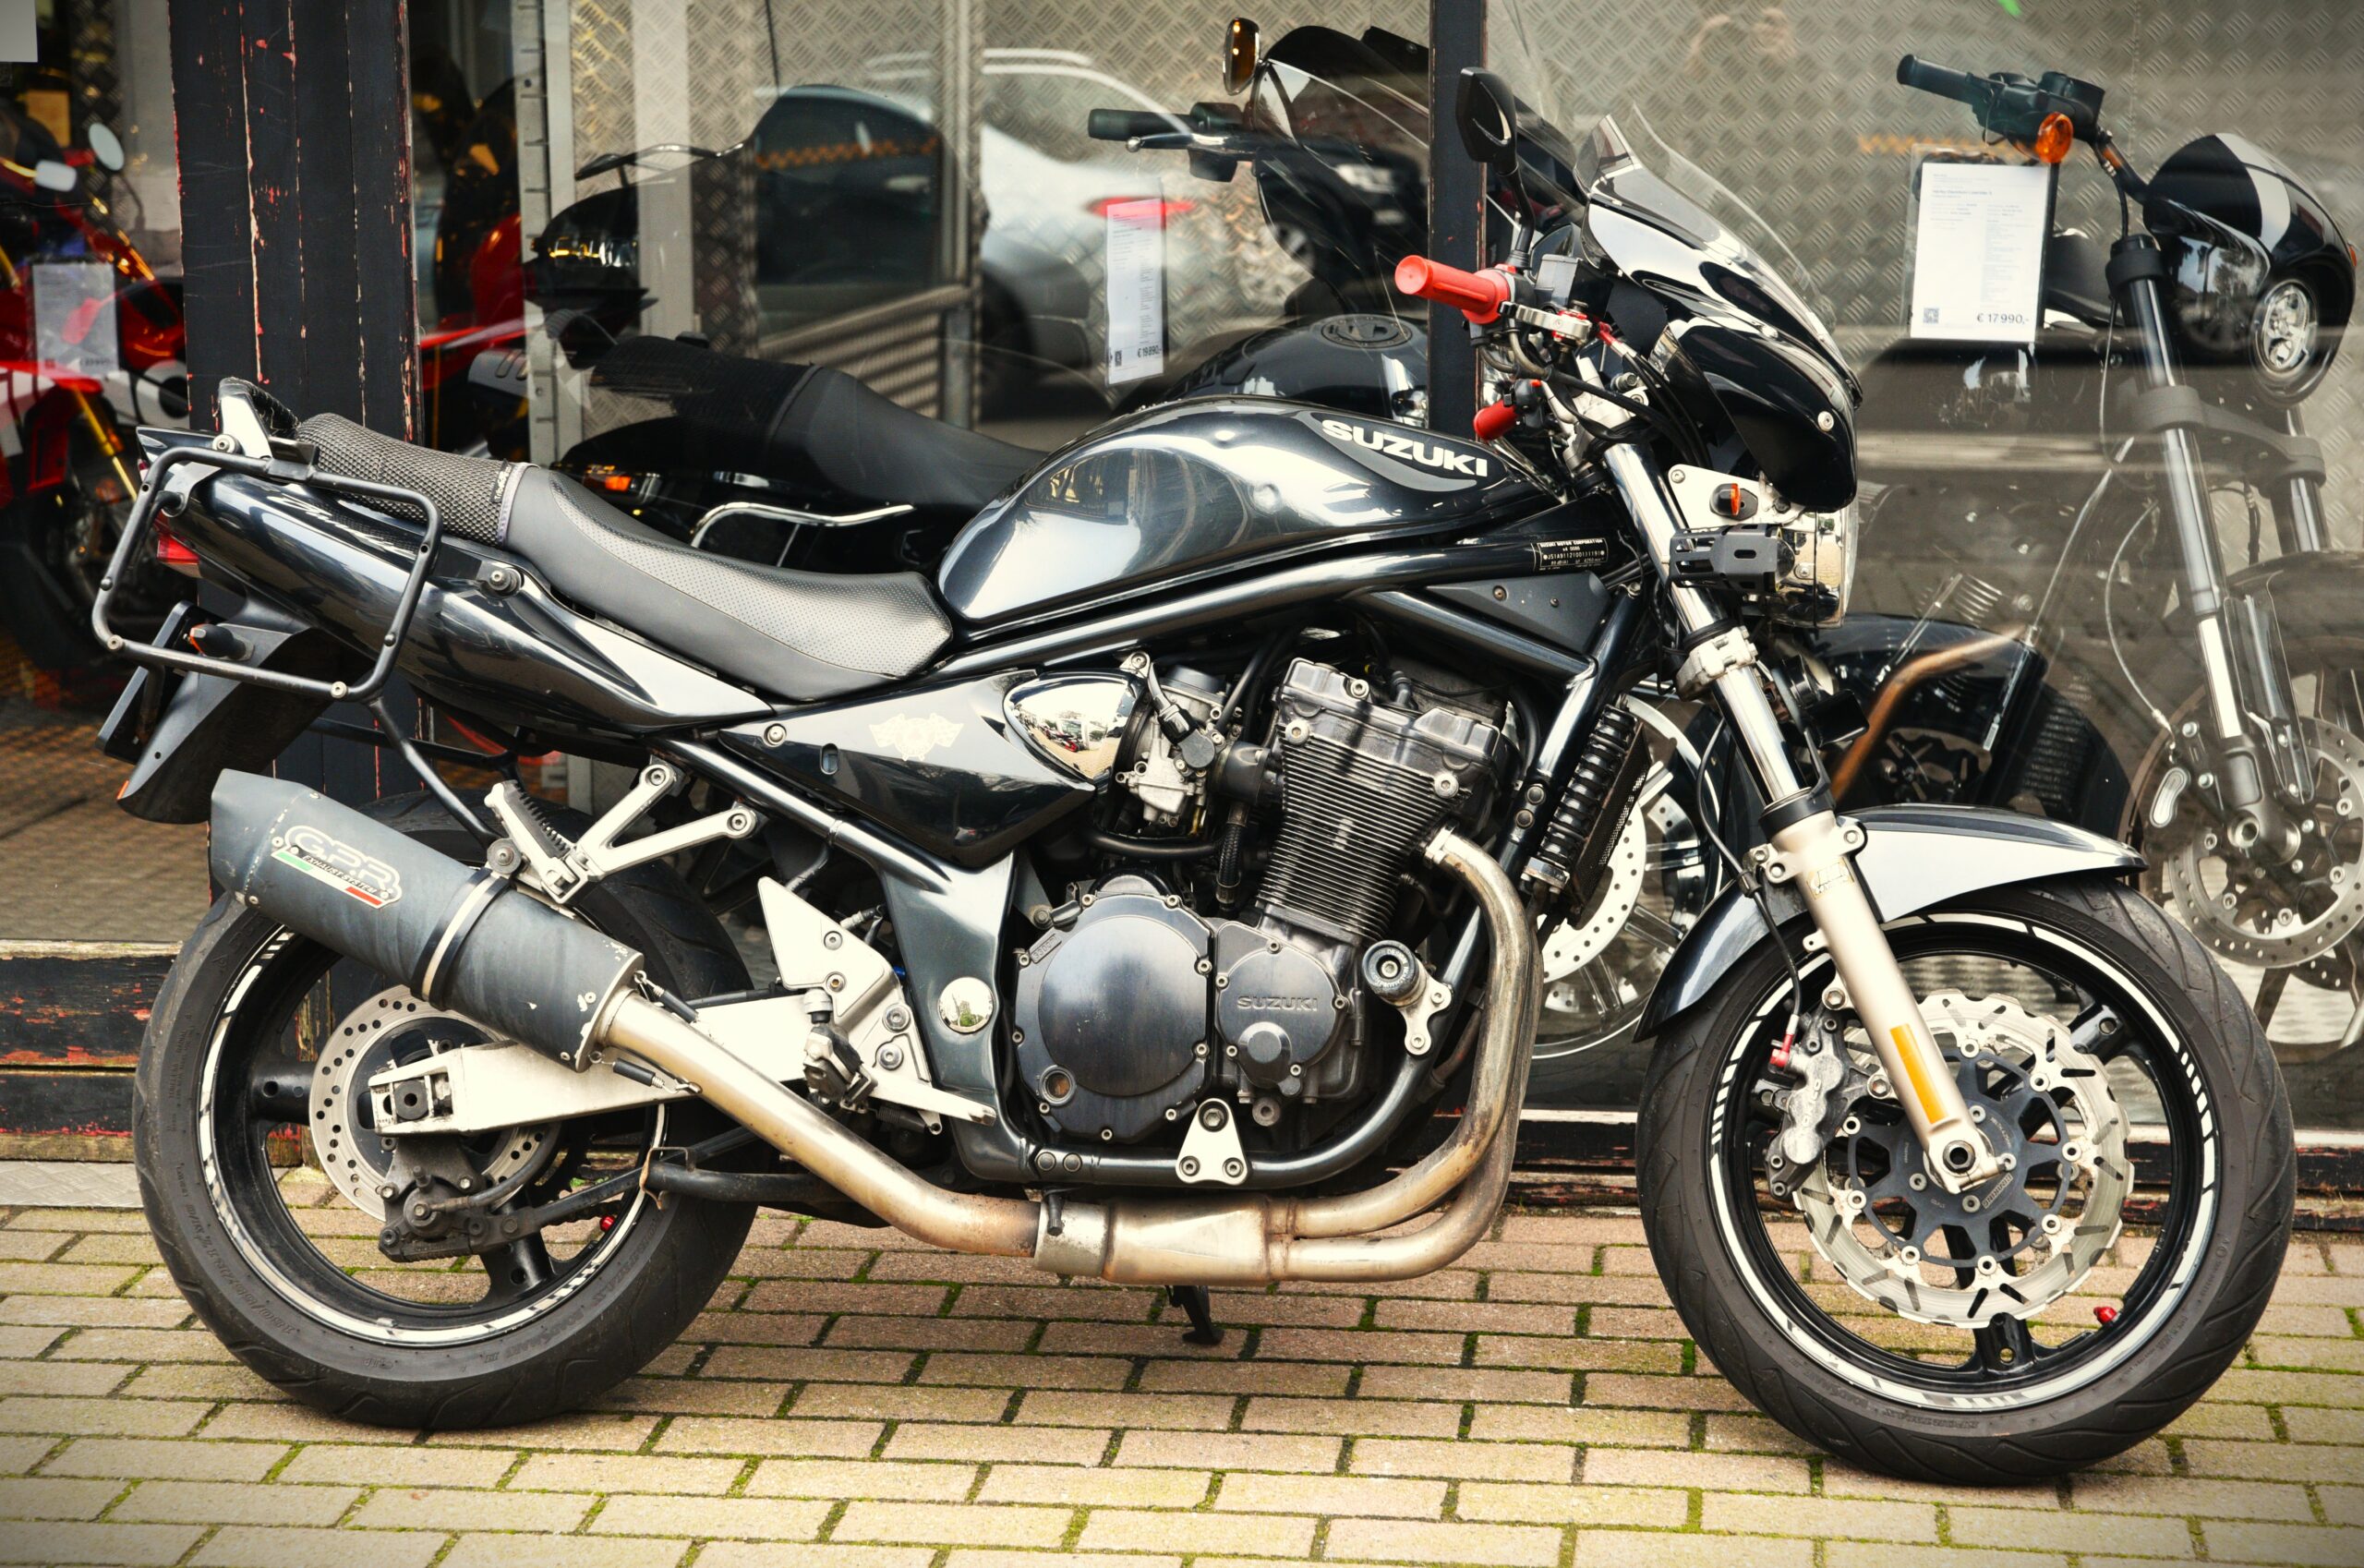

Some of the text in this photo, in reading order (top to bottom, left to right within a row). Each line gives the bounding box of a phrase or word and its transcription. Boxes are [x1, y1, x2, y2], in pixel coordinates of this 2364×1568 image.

[1321, 419, 1488, 477] SUZUKI
[302, 854, 379, 894] EXHAUST SYSTEM
[1237, 995, 1318, 1011] SUZUKI
[1983, 1174, 2013, 1208] BRAKING
